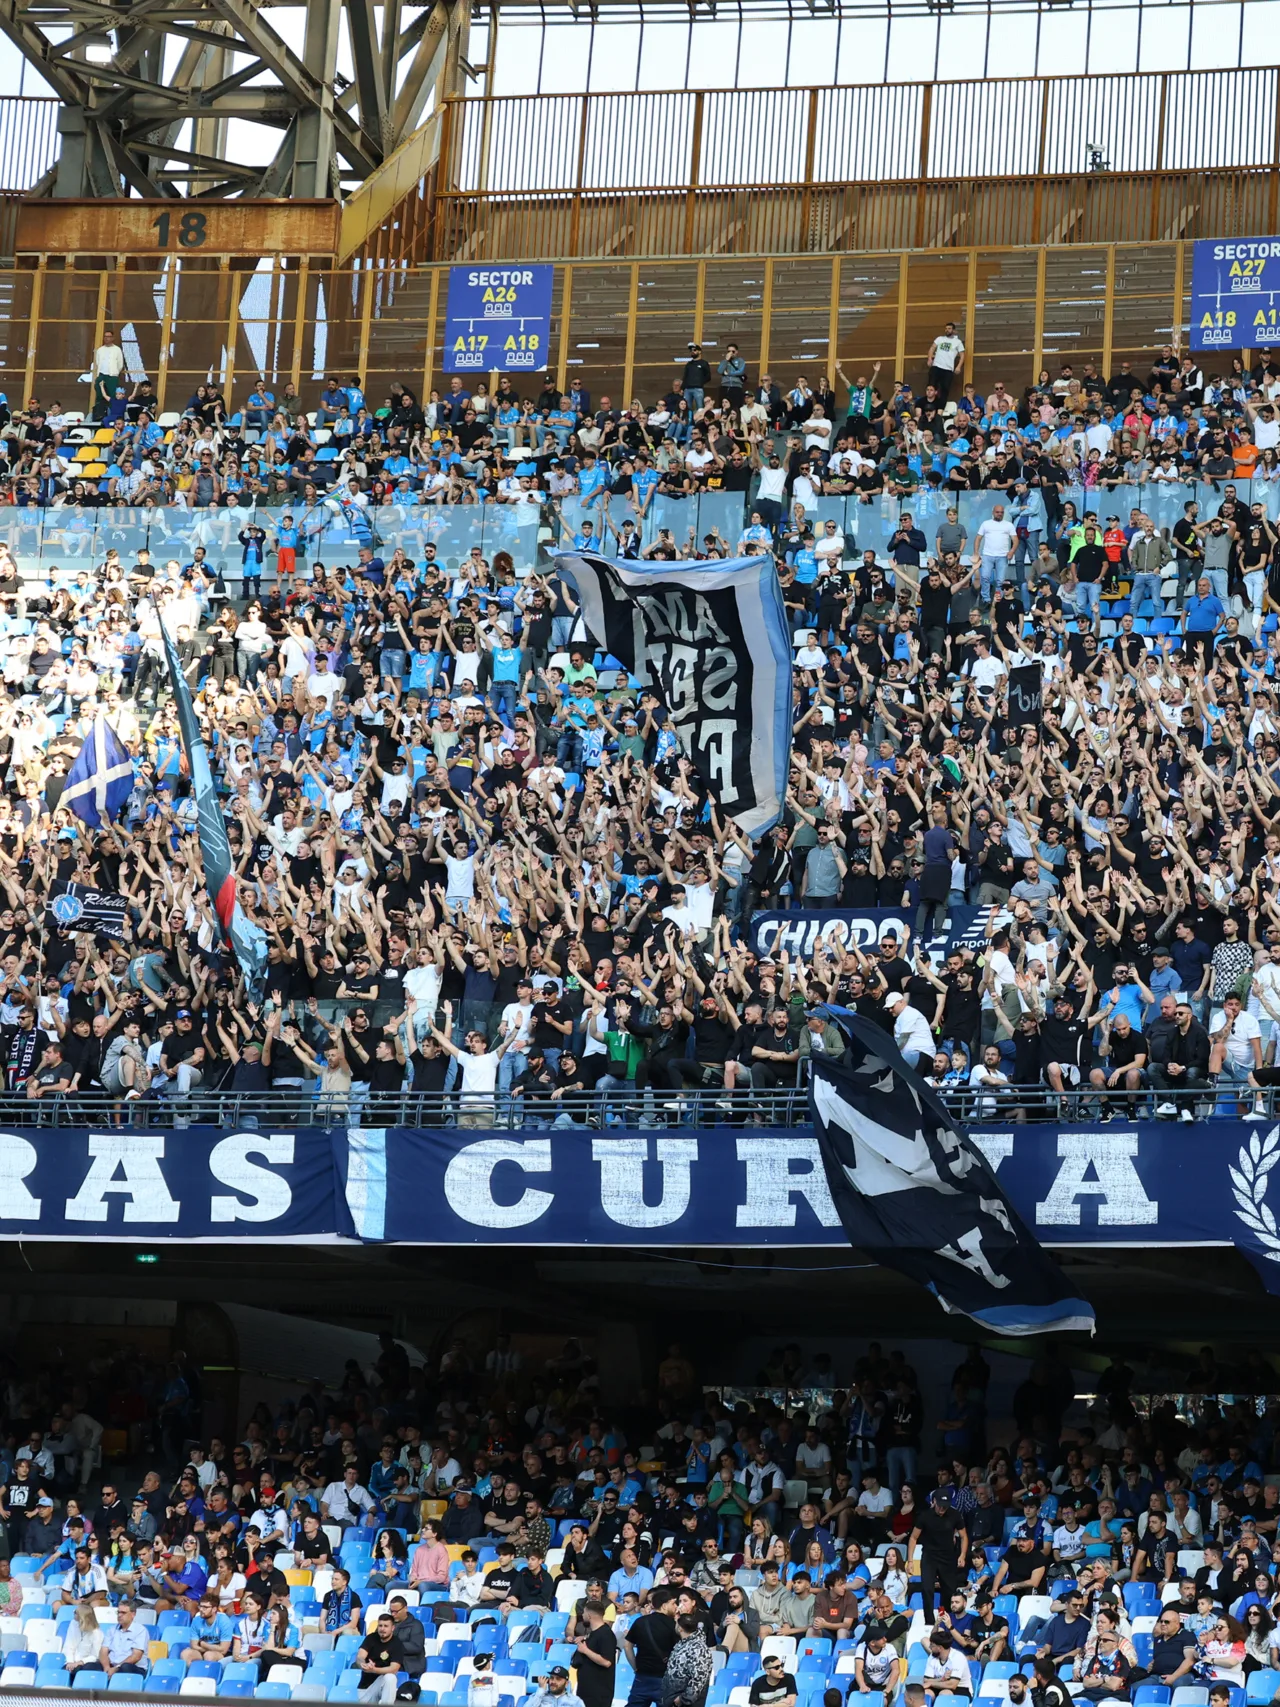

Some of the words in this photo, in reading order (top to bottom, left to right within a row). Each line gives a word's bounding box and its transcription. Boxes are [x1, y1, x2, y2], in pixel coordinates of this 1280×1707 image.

[153, 212, 207, 247] 18
[1228, 259, 1266, 277] A27
[468, 271, 534, 287] SECTOR
[481, 287, 517, 302] A26
[1200, 311, 1237, 328] A18
[453, 335, 489, 351] A17
[503, 334, 539, 350] A18
[60, 900, 76, 917] N
[84, 892, 127, 908] Ribelli
[444, 1132, 1159, 1228] CURA
[491, 1579, 511, 1587] adidas
